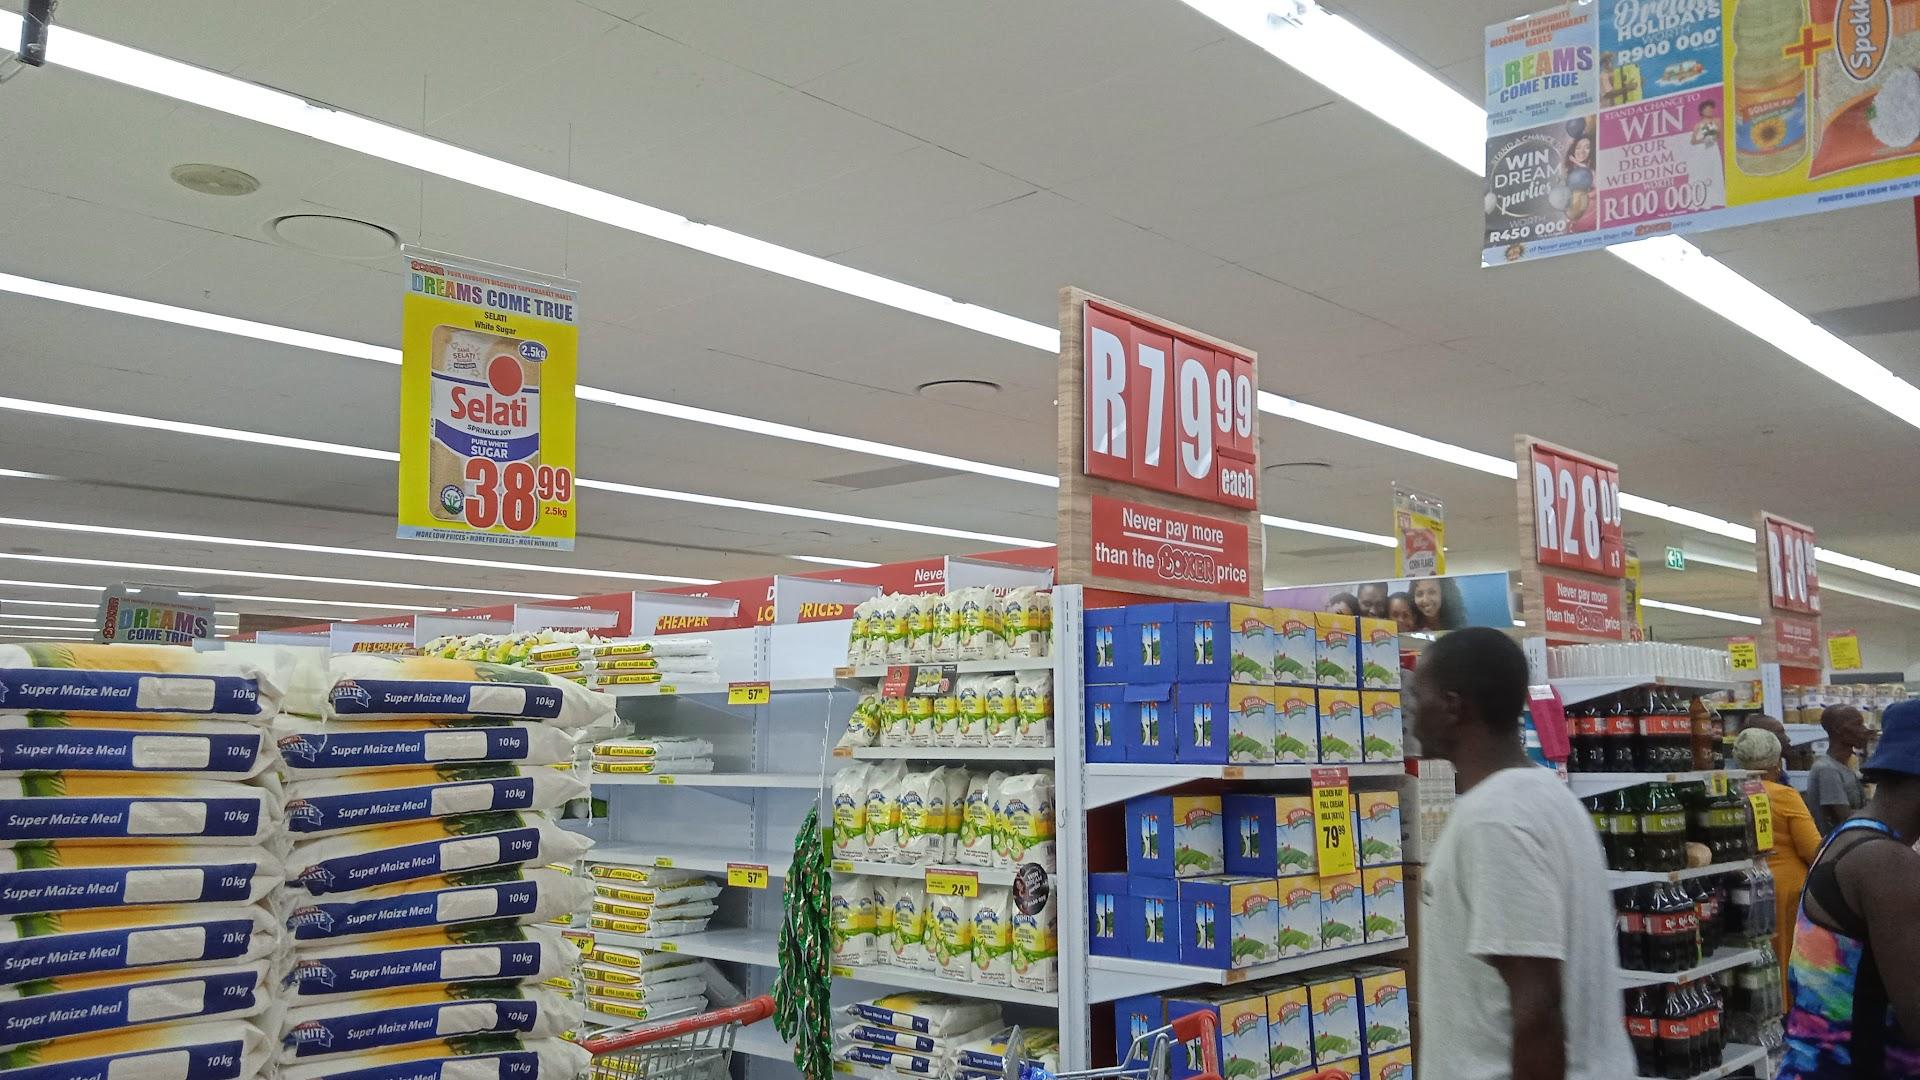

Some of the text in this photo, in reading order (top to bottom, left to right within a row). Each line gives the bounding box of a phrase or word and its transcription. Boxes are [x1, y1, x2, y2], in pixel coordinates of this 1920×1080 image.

[1618, 0, 1720, 42] HOLIDAYS
[1618, 40, 1670, 66] R900
[1488, 46, 1592, 96] DREAMS
[1500, 73, 1579, 103] COME TRUE
[1686, 93, 1700, 102] TO
[1619, 105, 1684, 142] WIN
[1622, 139, 1667, 157] YOUR
[1506, 148, 1549, 170] WIN
[1619, 151, 1674, 172] DREAM
[1495, 163, 1561, 189] DREAM
[1607, 161, 1687, 187] WEDDING
[1498, 180, 1551, 215] parties
[1604, 190, 1658, 221] R100
[1489, 226, 1530, 243] R450
[411, 273, 573, 322] DREAMS COME TRUE
[484, 311, 507, 323] SELATI
[474, 320, 517, 335] White Sugar
[522, 345, 546, 359] 2.5kg
[450, 386, 528, 428] Selati
[467, 424, 499, 436] SPRINKLE
[471, 438, 508, 448] PURE WHITE
[471, 446, 508, 458] SUGAR
[1221, 466, 1254, 500] each
[465, 457, 572, 532] 38 99
[545, 507, 568, 517] 2.5kg
[1122, 507, 1224, 544] Never pay more
[1095, 543, 1247, 583] than the BOXER price
[1557, 582, 1608, 605] Never pay more
[119, 607, 207, 639] DREAMS
[656, 616, 709, 630] CHEAPER
[1546, 607, 1563, 623] than
[1564, 610, 1575, 624] the
[1605, 616, 1620, 632] price
[128, 629, 162, 641] COME
[1734, 659, 1747, 668] 34
[20, 683, 132, 698] Super Maize Meal
[232, 689, 256, 702] 10kg
[384, 693, 465, 704] Super Maize Meal
[748, 689, 758, 700] 57
[535, 696, 555, 708] 10kg
[15, 744, 126, 756] Super Maize Meal
[331, 742, 420, 757] Super Maize Meal
[498, 737, 520, 748] 10kg
[227, 746, 251, 758] 10kg
[505, 789, 526, 799] 10kg
[338, 799, 427, 820] Super Maize Meal
[1320, 800, 1344, 809] FULL CREAM
[8, 813, 122, 829] Super Maize Meal
[224, 811, 249, 823] 10kg
[1323, 825, 1339, 848] 79
[511, 839, 532, 851] 10kg
[349, 855, 436, 879] Super Maize Meal
[221, 877, 247, 889] 10kg
[747, 872, 757, 883] 57
[3, 882, 119, 901] Super Maize Meal
[509, 892, 530, 904] 10kg
[952, 884, 964, 896] 24
[347, 904, 433, 925] Super Maize Meal
[4, 945, 120, 970] Super Maize Meal
[512, 952, 533, 964] 10kg
[350, 961, 436, 981] Super Maize Meal
[223, 985, 249, 998] 10kg
[6, 1002, 122, 1029] Super Maize Meal
[348, 1018, 433, 1040] Super Maize Meal
